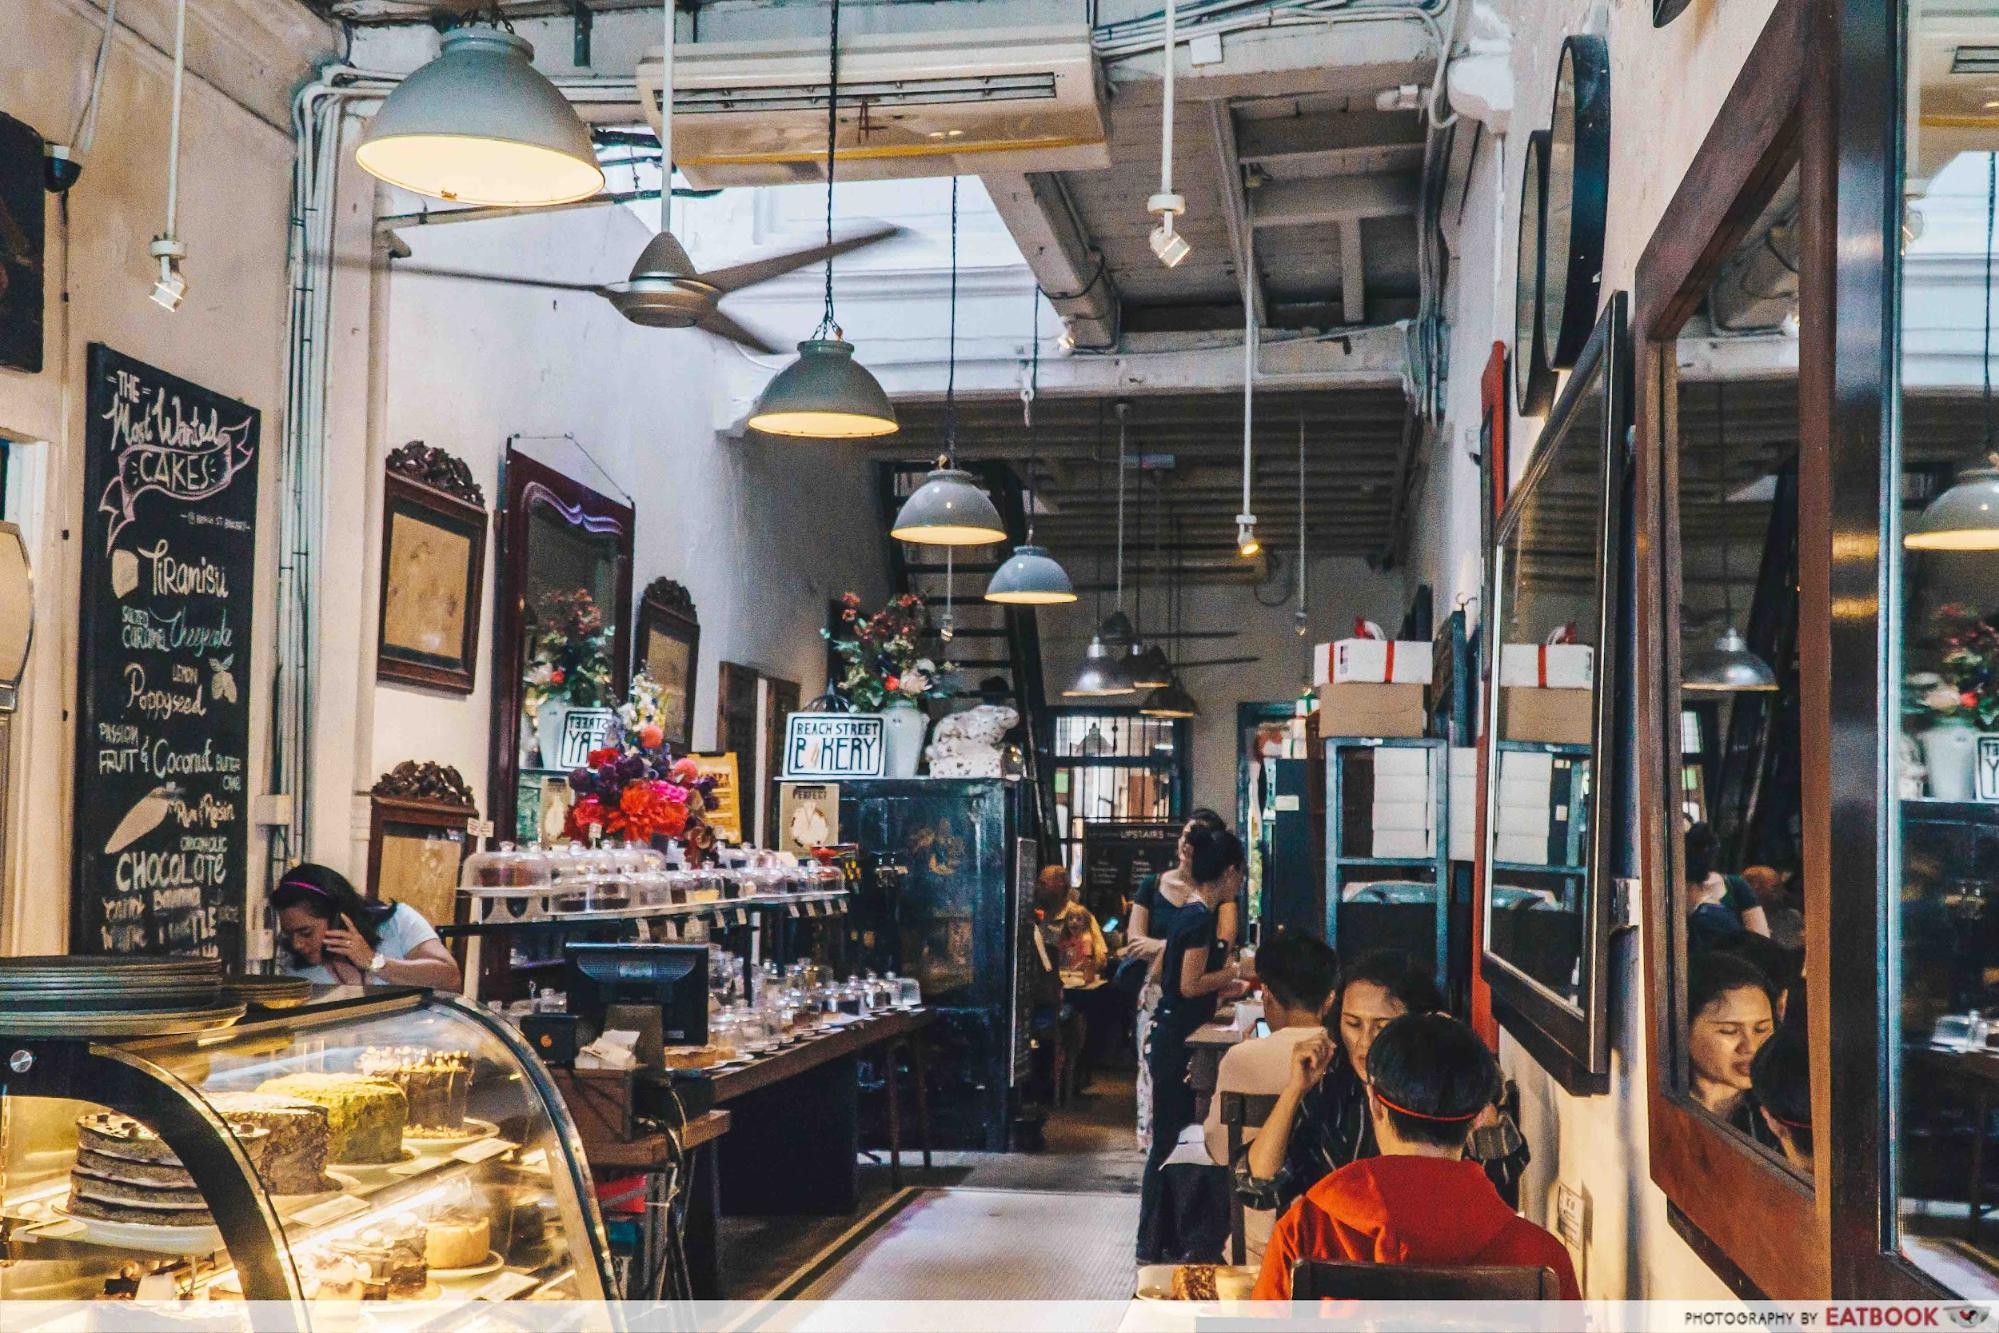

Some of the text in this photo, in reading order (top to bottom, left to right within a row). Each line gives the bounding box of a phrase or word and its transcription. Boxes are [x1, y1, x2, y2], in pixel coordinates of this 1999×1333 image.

[116, 369, 141, 403] THE
[139, 451, 209, 491] CAKES
[796, 722, 879, 735] BEACH STREET
[99, 749, 139, 775] FRUIT
[153, 738, 214, 779] Coconut
[794, 737, 877, 770] BKERY
